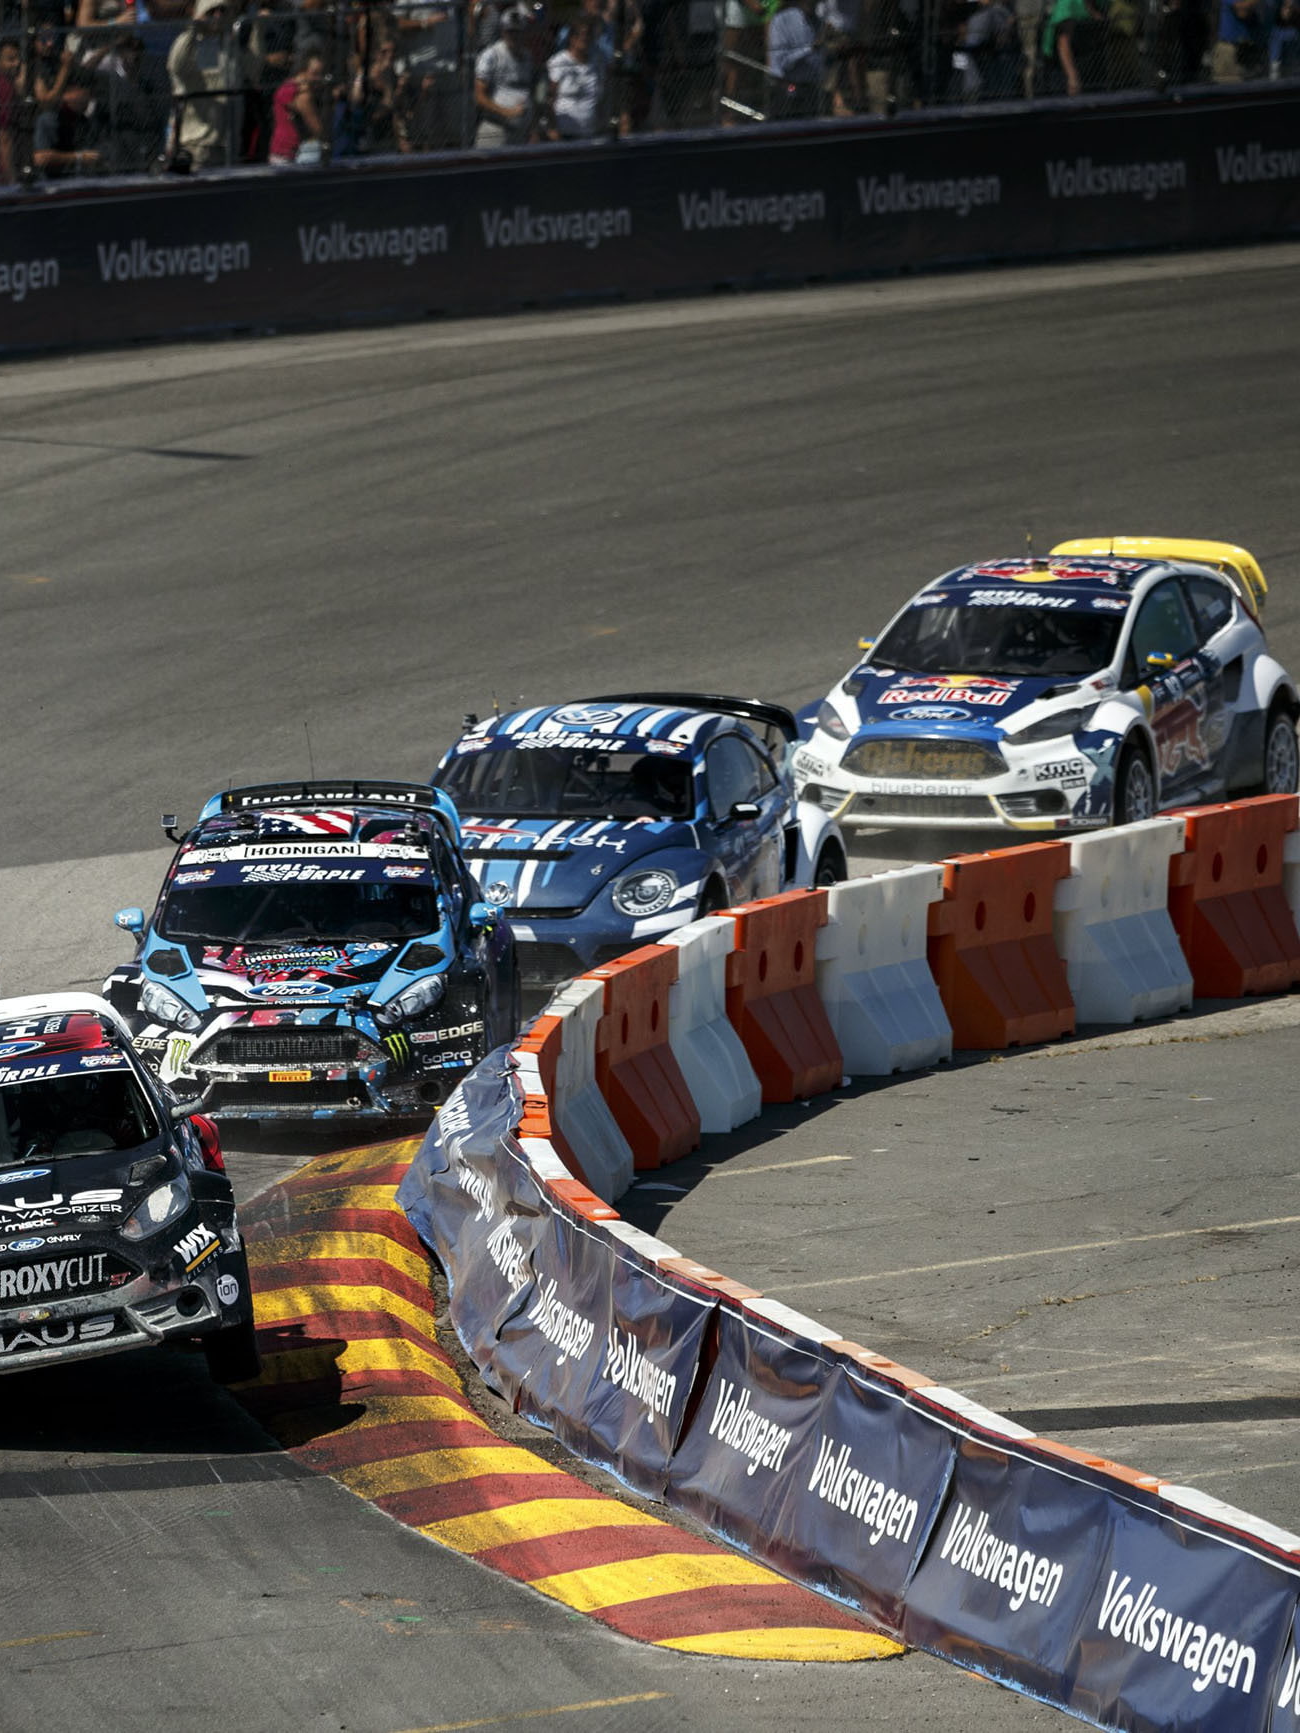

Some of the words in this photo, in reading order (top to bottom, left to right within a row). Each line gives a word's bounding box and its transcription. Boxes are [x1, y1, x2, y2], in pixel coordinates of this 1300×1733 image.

[857, 174, 1001, 217] Volkswagen
[1045, 158, 1186, 201] Volkswagen
[481, 207, 631, 250] Volkswagen
[678, 189, 825, 233] Volkswagen
[97, 240, 250, 284] Volkswagen
[298, 223, 448, 266] Volkswagen
[878, 688, 944, 704] Red
[946, 688, 1011, 706] Bull
[549, 738, 626, 751] PURPLE
[871, 782, 968, 796] bluebeam
[240, 863, 302, 873] ROYAL
[280, 869, 366, 882] PURPLE
[131, 1036, 168, 1050] EDGE
[438, 1021, 484, 1041] EDGE
[421, 1050, 472, 1064] GoPro
[15, 1203, 124, 1221] VAPORIZER
[172, 1222, 218, 1264] WIX
[217, 1278, 238, 1297] ion
[708, 1377, 793, 1477] Volkswagen
[807, 1434, 919, 1546] Volkswagen
[939, 1502, 1064, 1612] Volkswagen
[1097, 1569, 1257, 1694] Volkswagen
